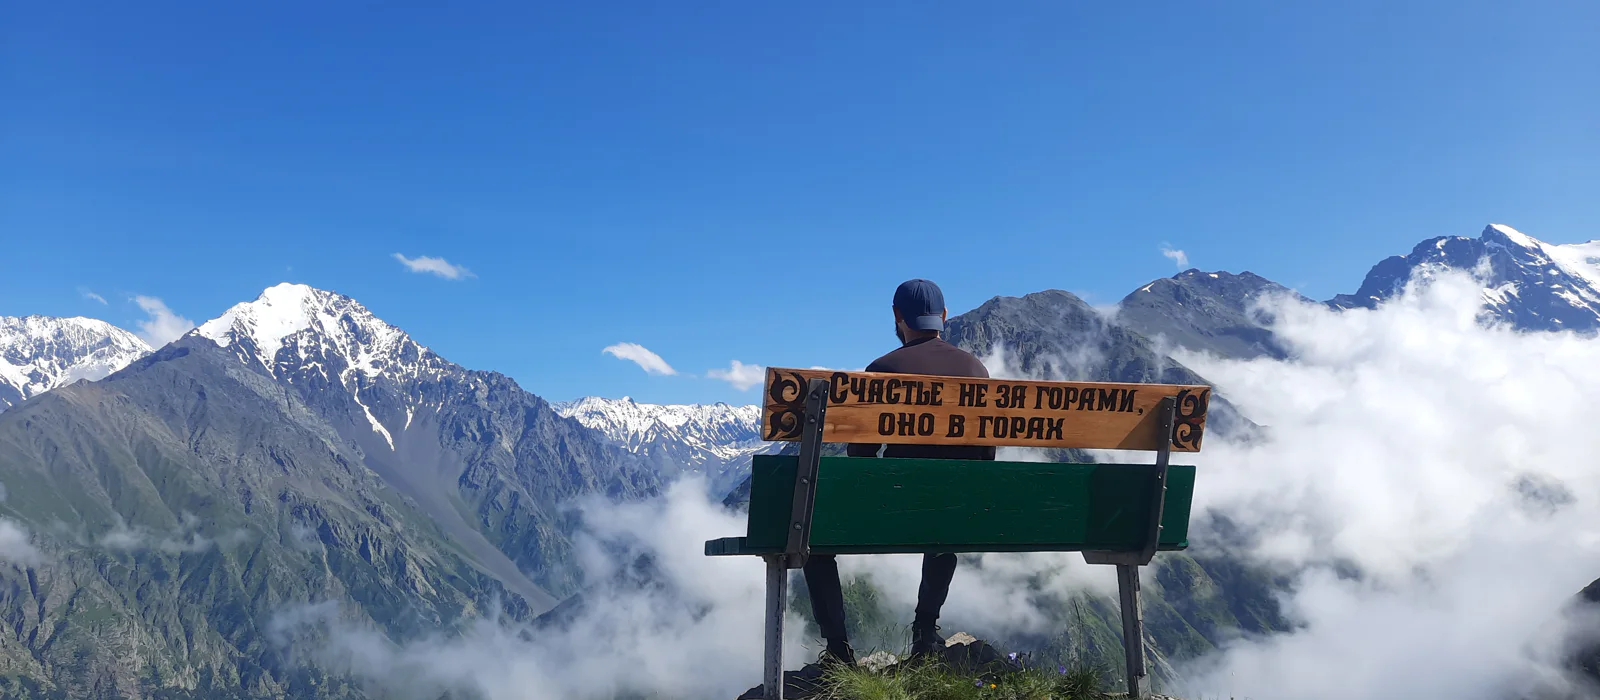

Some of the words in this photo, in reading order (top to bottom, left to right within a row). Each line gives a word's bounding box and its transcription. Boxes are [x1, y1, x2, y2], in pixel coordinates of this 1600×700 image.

[958, 383, 988, 407] НЕ
[995, 384, 1028, 409] ЗА
[1033, 386, 1144, 416] ГОРАМИ,
[877, 412, 935, 436] ОНО
[945, 414, 965, 438] В
[977, 415, 1065, 440] ГОРАХ
